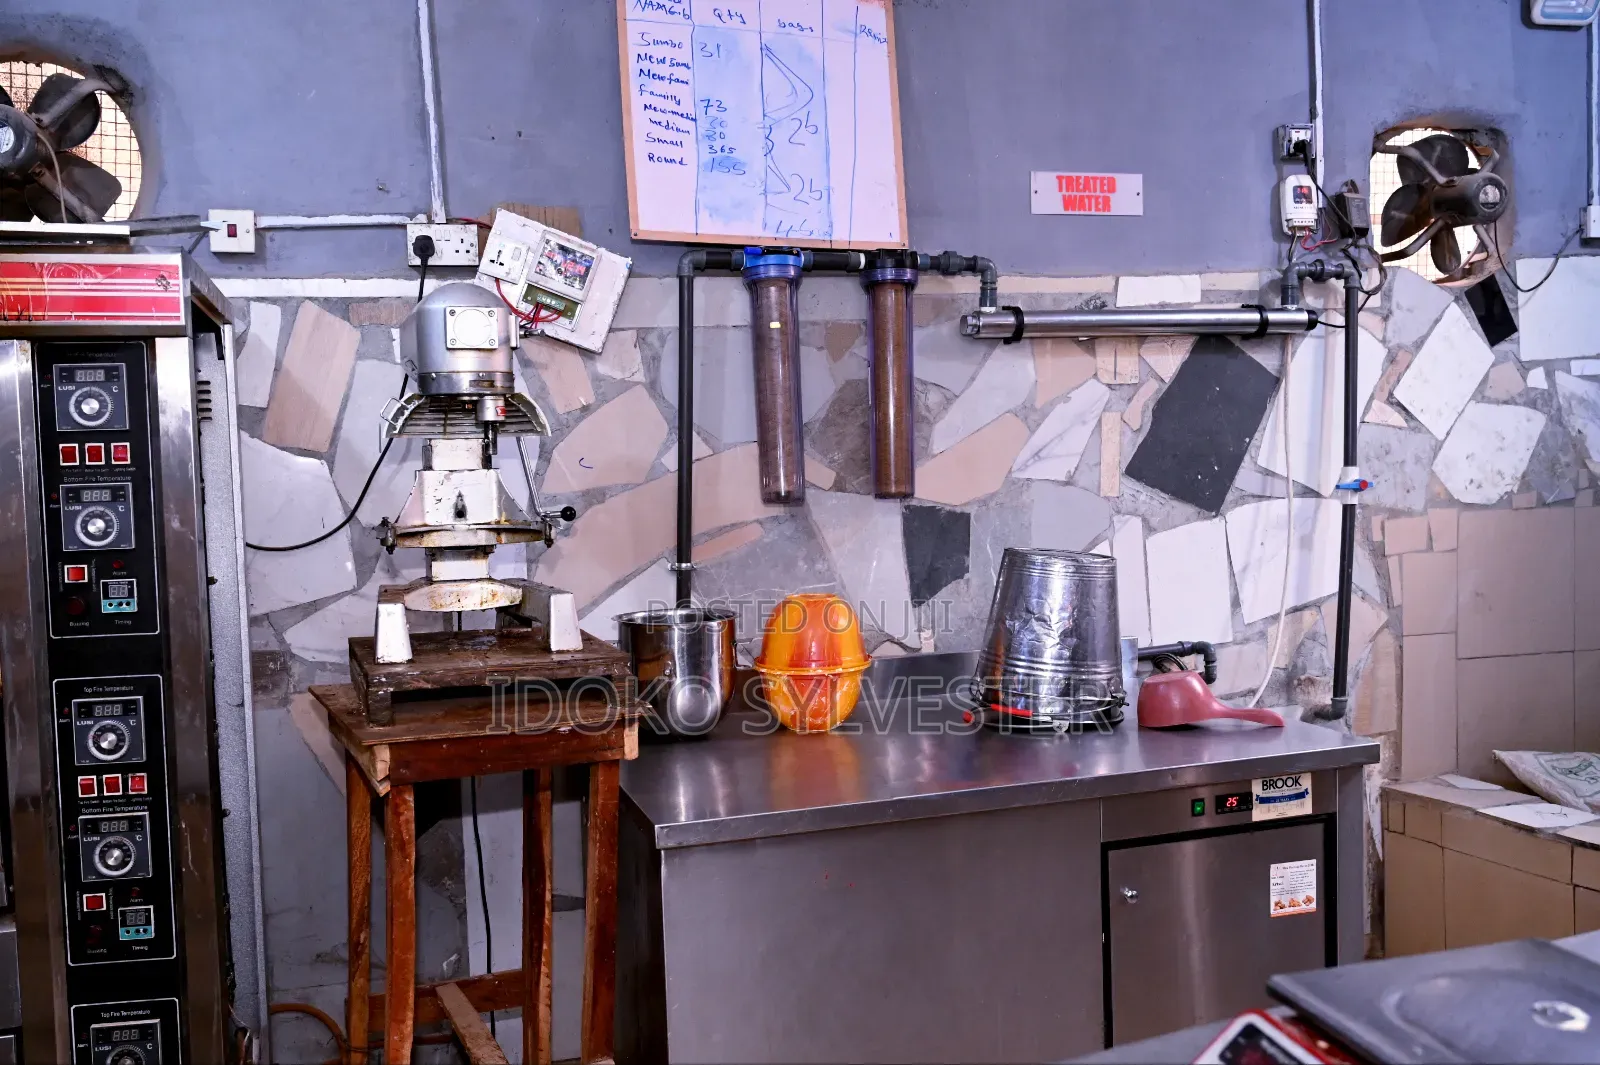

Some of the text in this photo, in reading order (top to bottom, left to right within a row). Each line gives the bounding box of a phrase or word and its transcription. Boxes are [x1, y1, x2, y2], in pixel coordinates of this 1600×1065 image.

[699, 98, 728, 116] 73
[645, 132, 684, 148] Small
[1056, 175, 1117, 194] TREATED
[1062, 194, 1111, 212] WATER
[1261, 775, 1303, 791] BROOK
